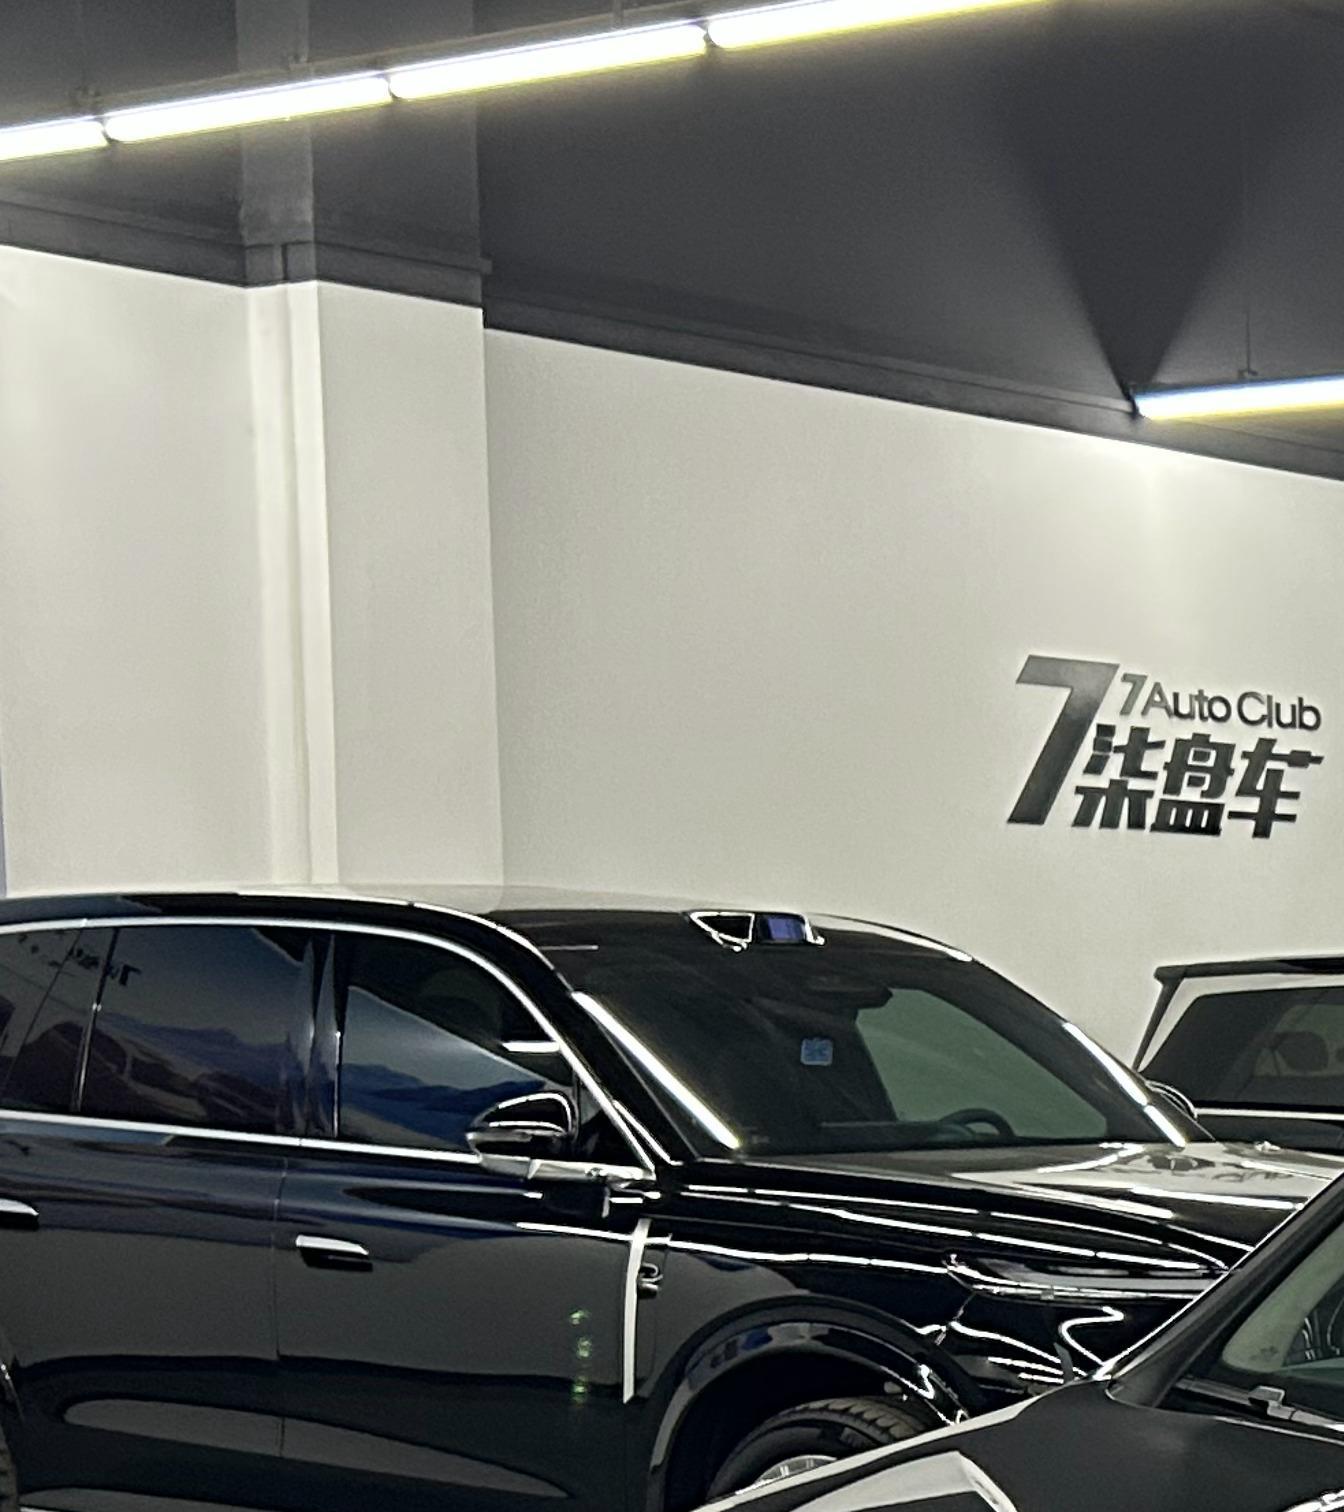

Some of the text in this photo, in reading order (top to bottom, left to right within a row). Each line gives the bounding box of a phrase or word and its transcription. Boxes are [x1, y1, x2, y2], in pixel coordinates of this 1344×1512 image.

[1236, 691, 1322, 731] Club
[1071, 723, 1324, 839] 柒盘车
